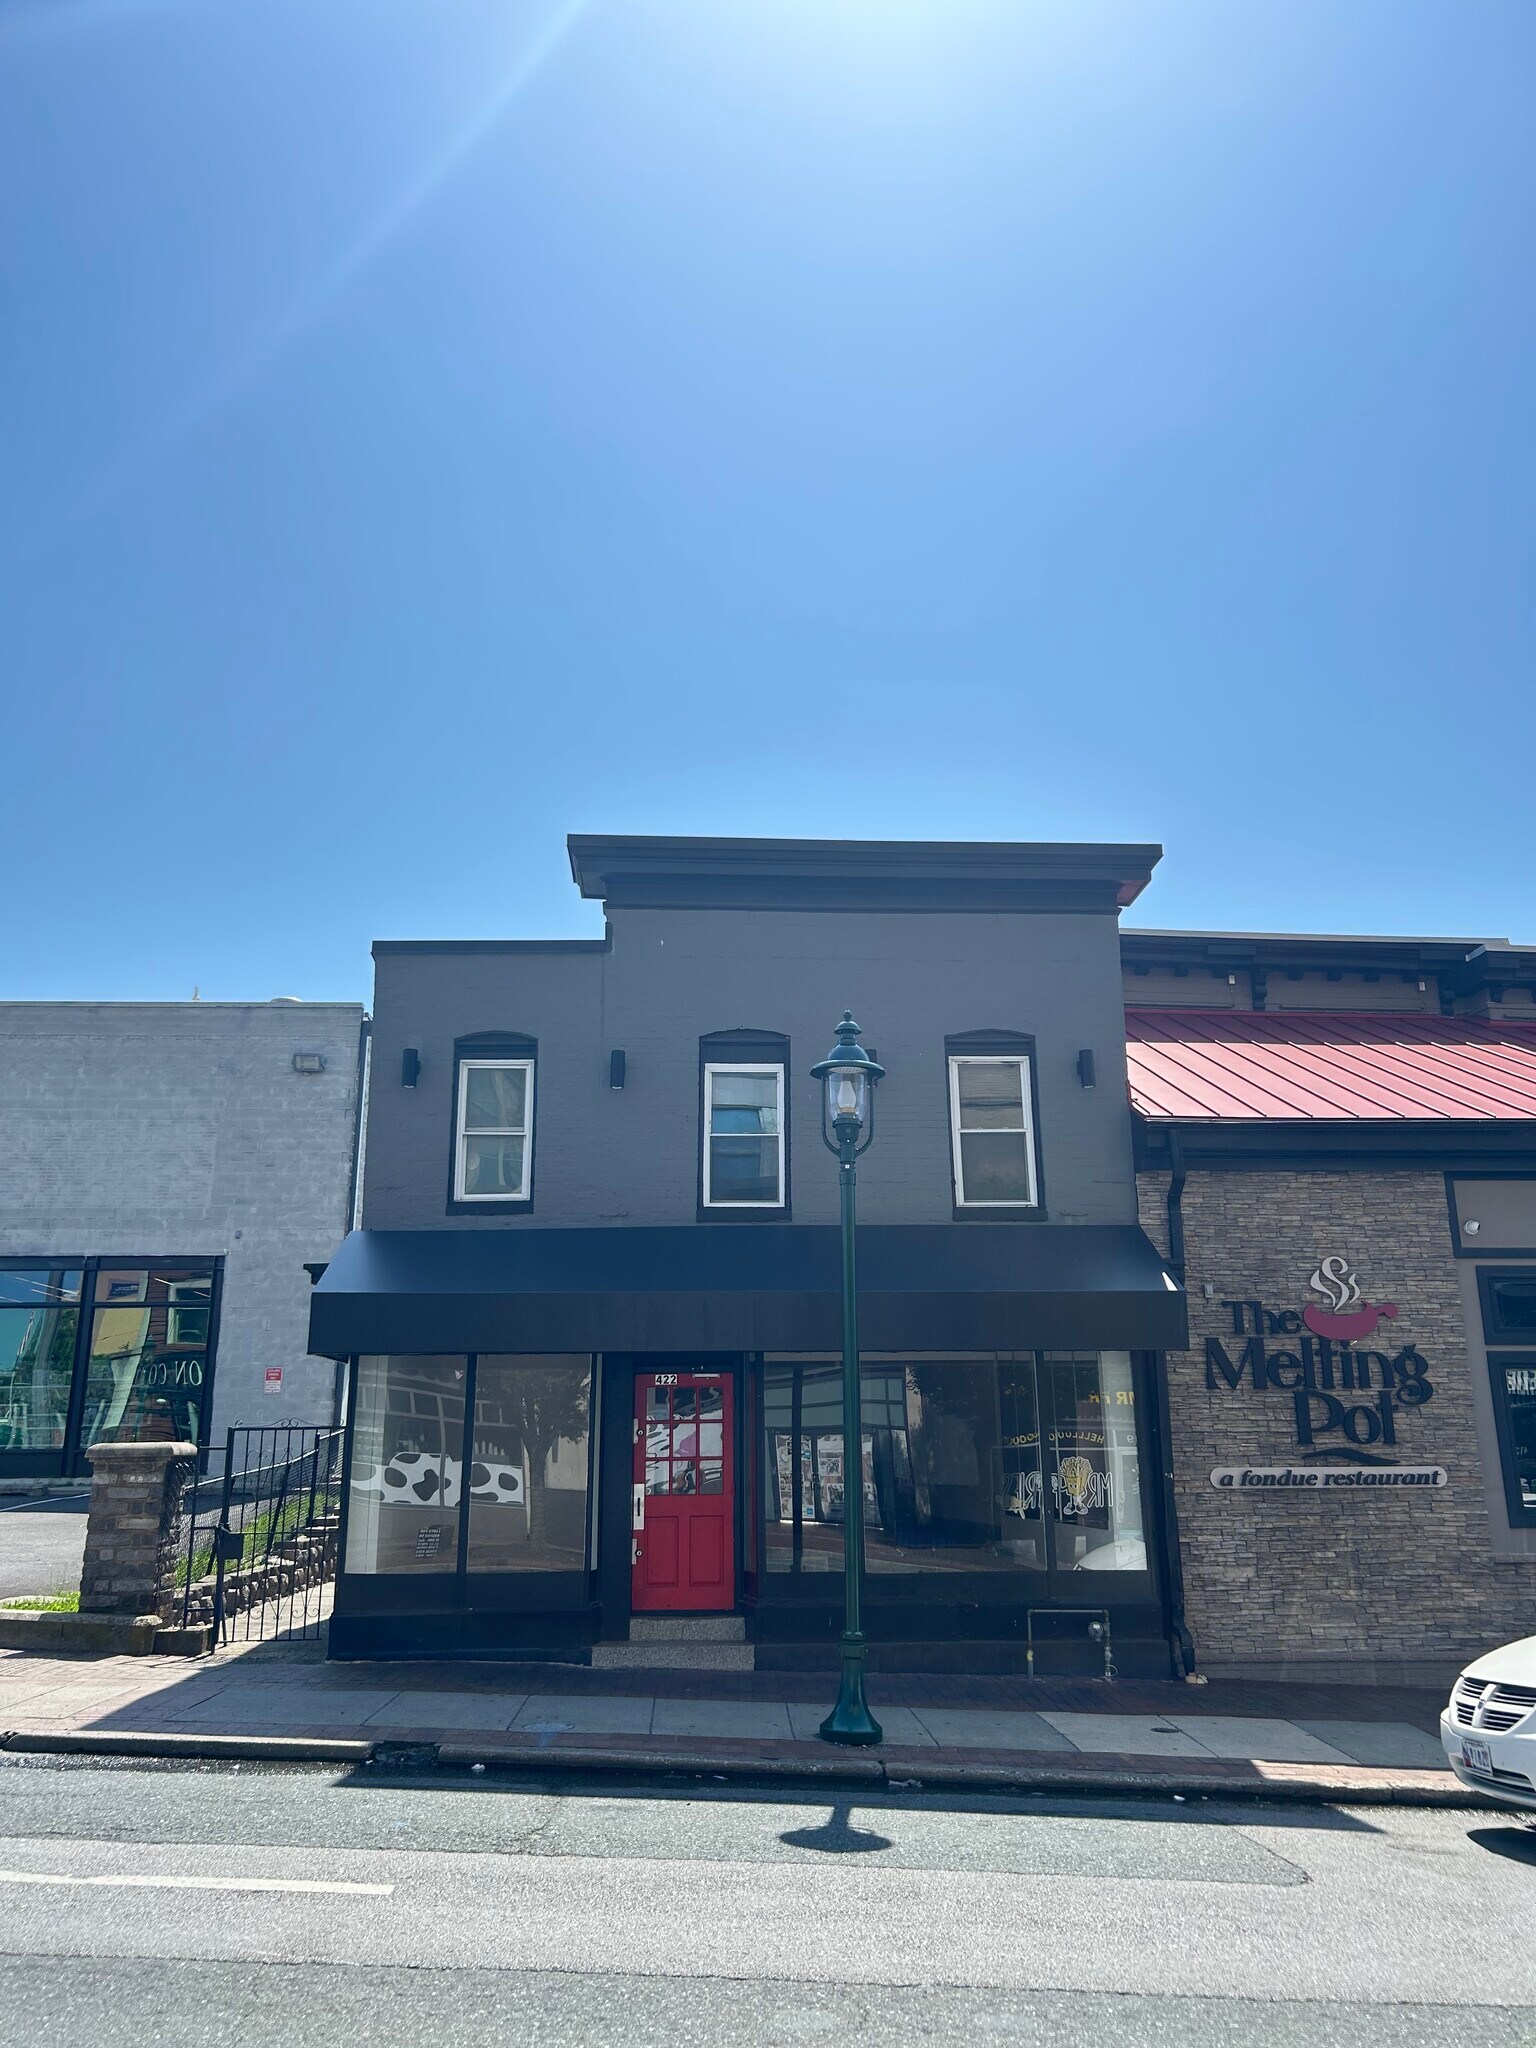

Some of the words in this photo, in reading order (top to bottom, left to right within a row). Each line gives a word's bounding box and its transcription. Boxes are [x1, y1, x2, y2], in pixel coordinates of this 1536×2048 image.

[1221, 1300, 1301, 1335] The
[655, 1374, 677, 1385] 422
[1205, 1337, 1433, 1405] Melting
[1293, 1390, 1399, 1444] Pot
[1219, 1474, 1234, 1487] a
[1239, 1470, 1318, 1487] fondue
[1323, 1470, 1441, 1487] restaurant
